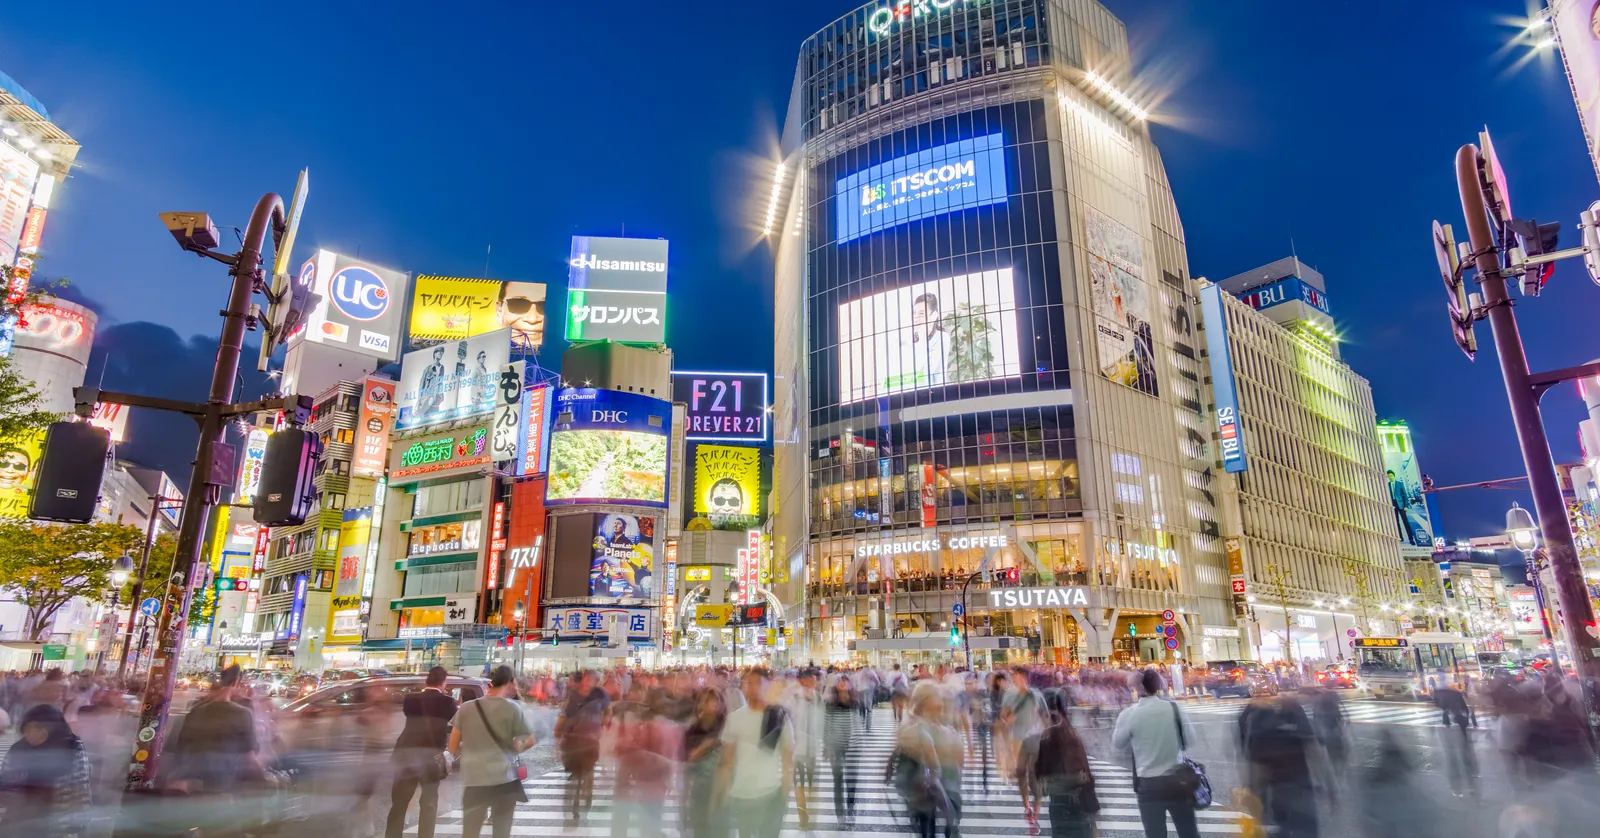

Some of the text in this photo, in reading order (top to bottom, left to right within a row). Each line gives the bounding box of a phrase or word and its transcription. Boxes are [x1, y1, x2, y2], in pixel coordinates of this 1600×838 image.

[336, 275, 384, 310] UC
[420, 292, 493, 309] ヤバババーン
[1248, 285, 1286, 309] IBU
[571, 305, 660, 325] サロンパス
[363, 334, 388, 349] VISA
[404, 391, 417, 402] ALL
[438, 381, 456, 393] BEST
[558, 393, 596, 402] DHC Channel
[692, 380, 742, 412] F21
[494, 365, 521, 457] もんじゃ
[591, 410, 628, 424] DHC
[686, 416, 761, 433] OREVER 21
[1217, 406, 1241, 461] SEIBU
[424, 445, 453, 464] 西村
[412, 540, 459, 555] Euphoria
[604, 548, 641, 559] Planets
[858, 535, 1007, 557] STARBUCKS COFFEE
[991, 588, 1089, 607] TSUTAYA
[551, 612, 646, 632] 大盛堂店
[221, 633, 260, 647] グルメタウン
